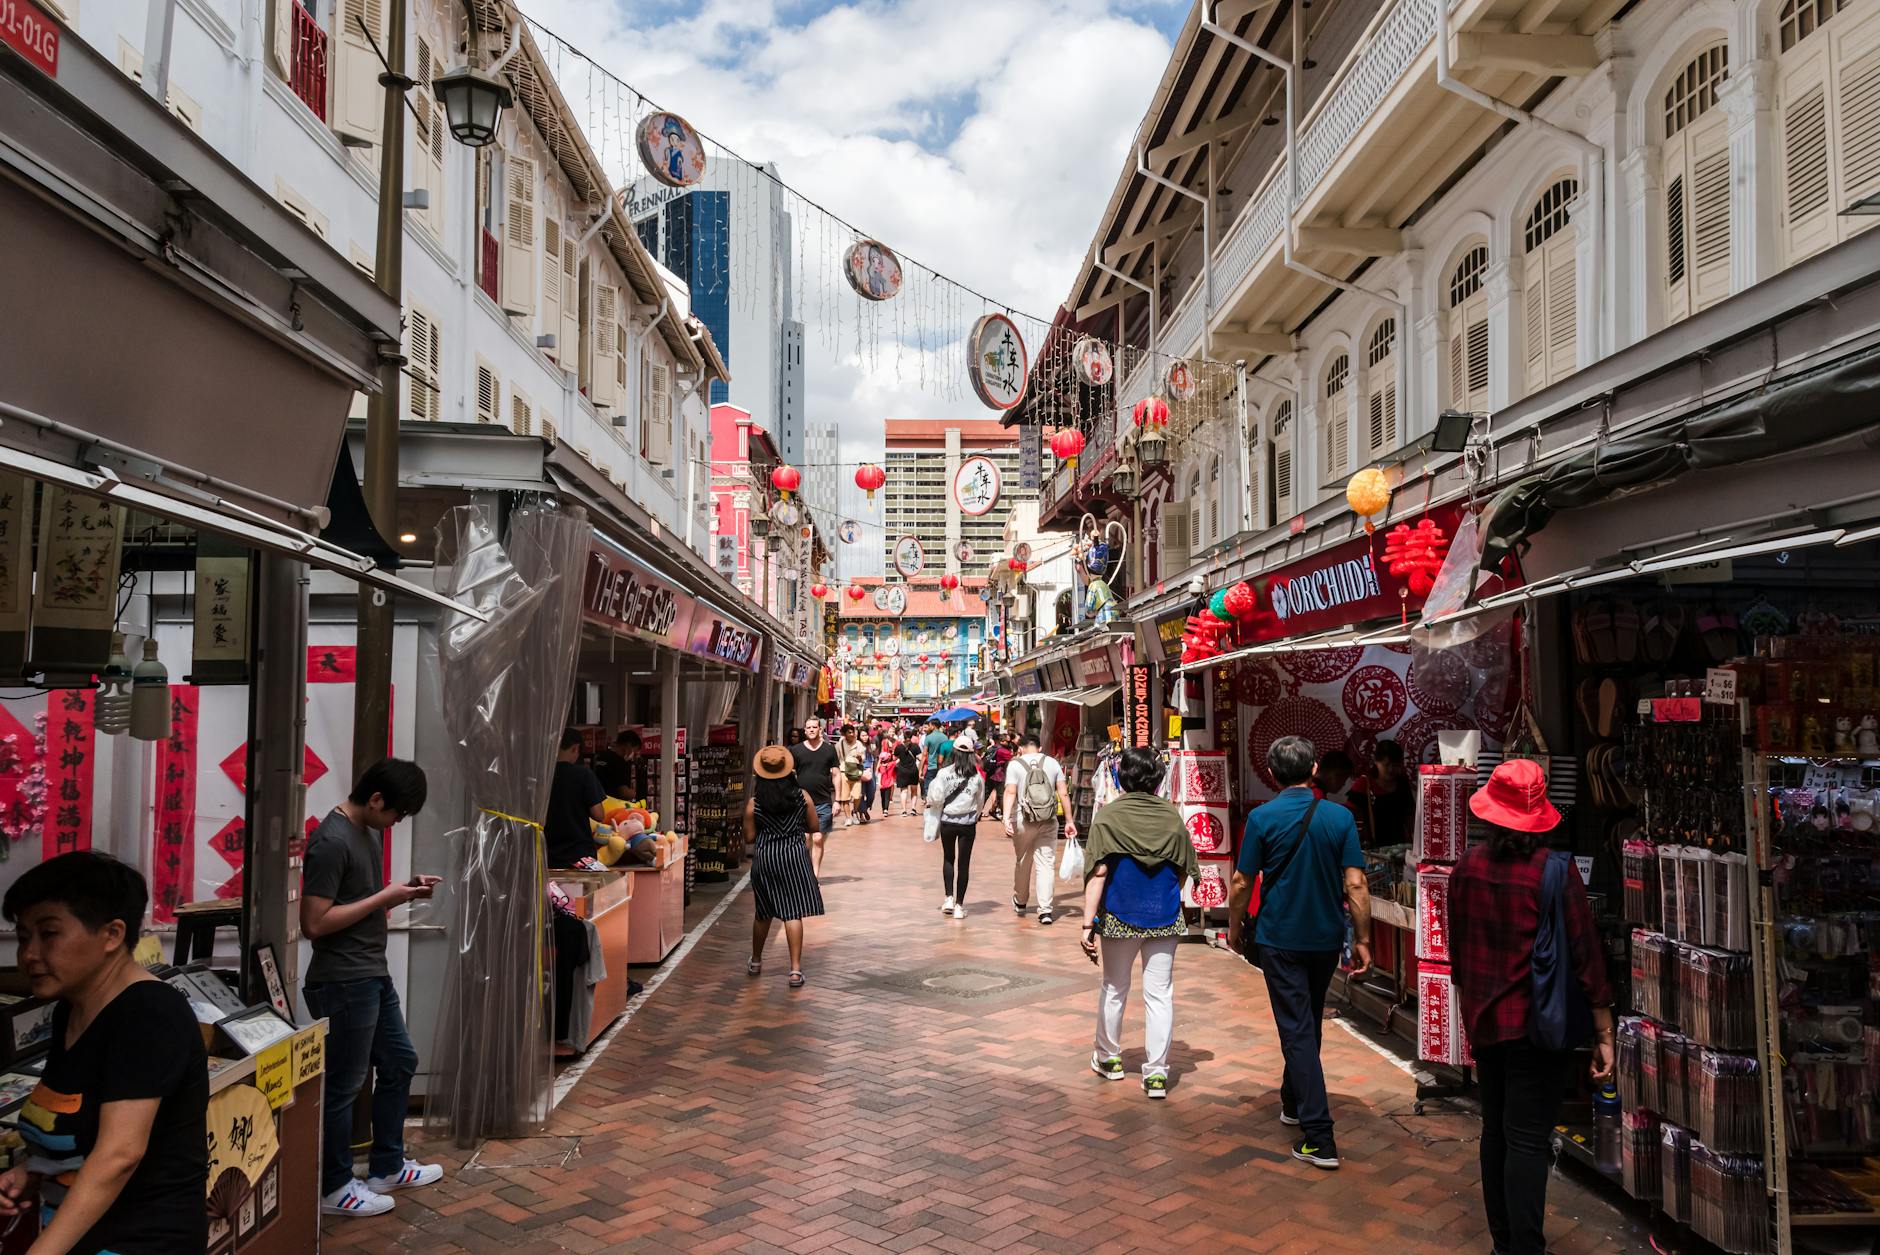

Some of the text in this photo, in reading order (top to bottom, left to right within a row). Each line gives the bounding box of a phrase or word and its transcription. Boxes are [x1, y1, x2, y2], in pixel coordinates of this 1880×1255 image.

[1002, 328, 1019, 397] 牛车水
[975, 462, 991, 505] 牛车水
[592, 553, 678, 636] THE GIFT SHOP
[1134, 667, 1148, 703] MONEY
[1721, 690, 1734, 700] $10
[1724, 680, 1733, 689] $6
